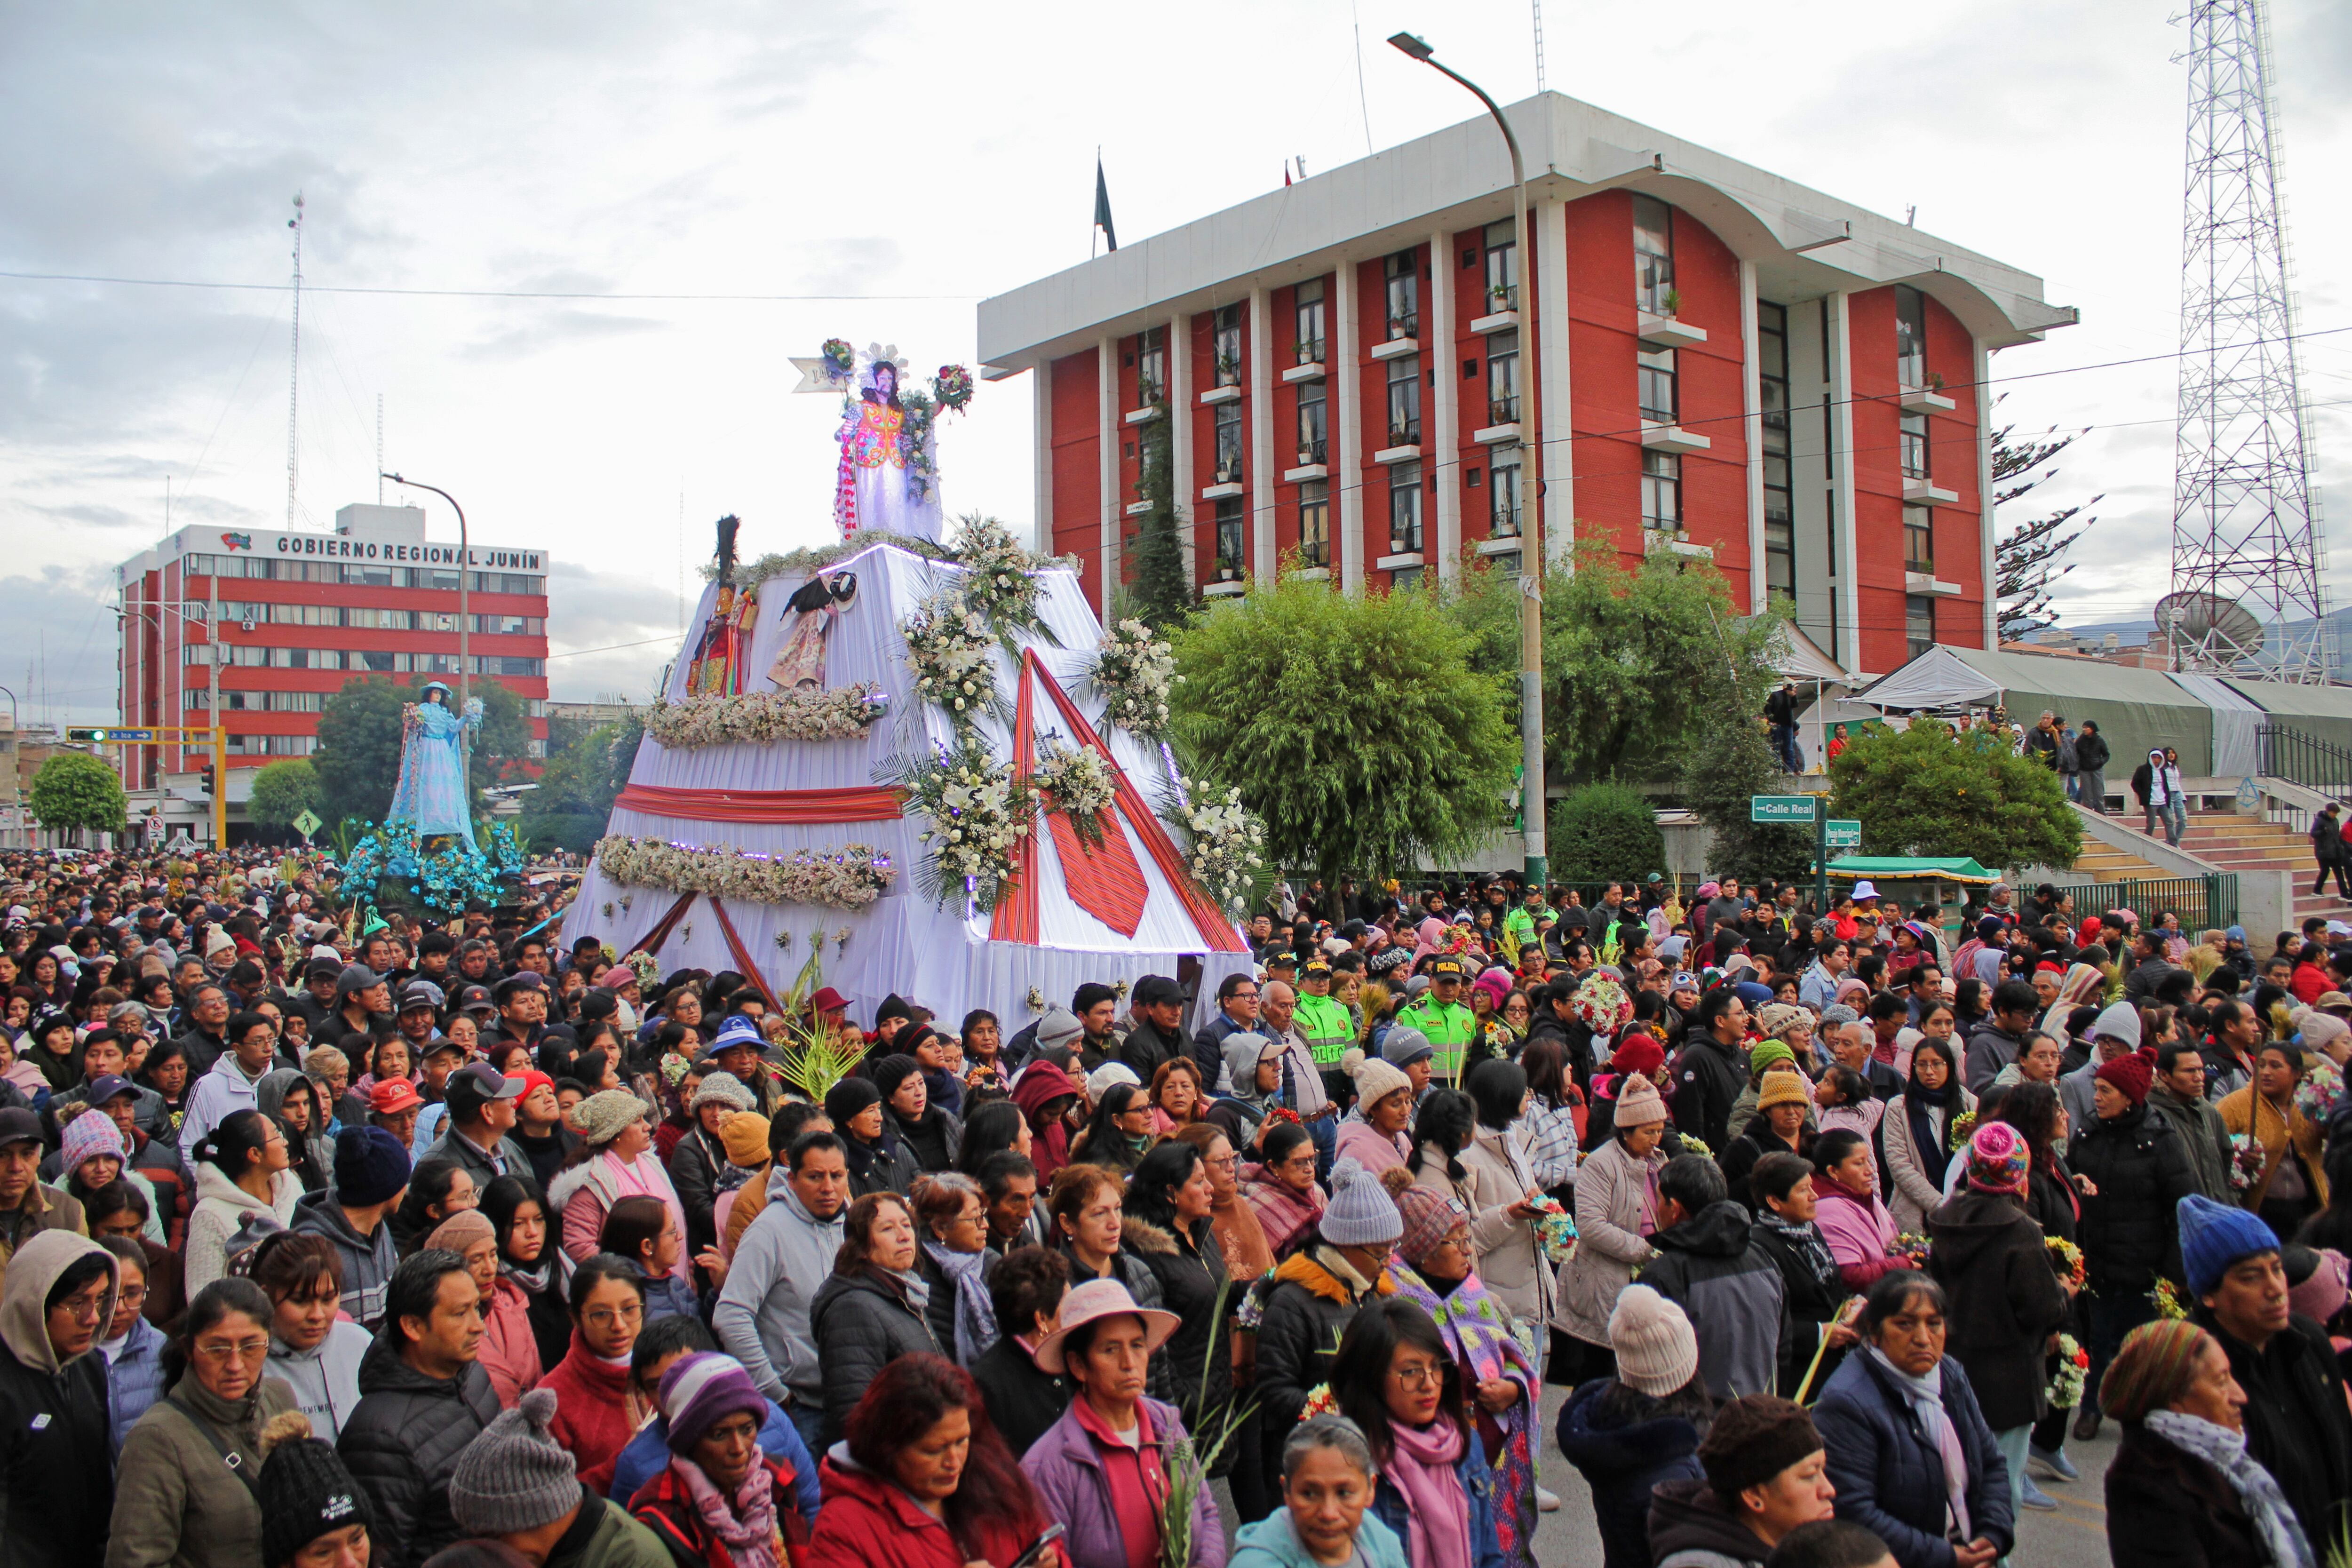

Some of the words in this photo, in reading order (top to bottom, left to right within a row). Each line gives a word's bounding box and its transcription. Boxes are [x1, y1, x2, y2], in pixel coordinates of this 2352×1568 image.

[278, 537, 377, 558] GOBIERNO
[486, 550, 539, 569] JUNÍN
[1766, 804, 1789, 814] Calle
[1791, 804, 1812, 814] Real
[1307, 961, 1327, 971] POLICIA
[1437, 962, 1460, 972] POLICIA
[1311, 1047, 1343, 1061] OLIC
[299, 1402, 338, 1414] EMEMBR
